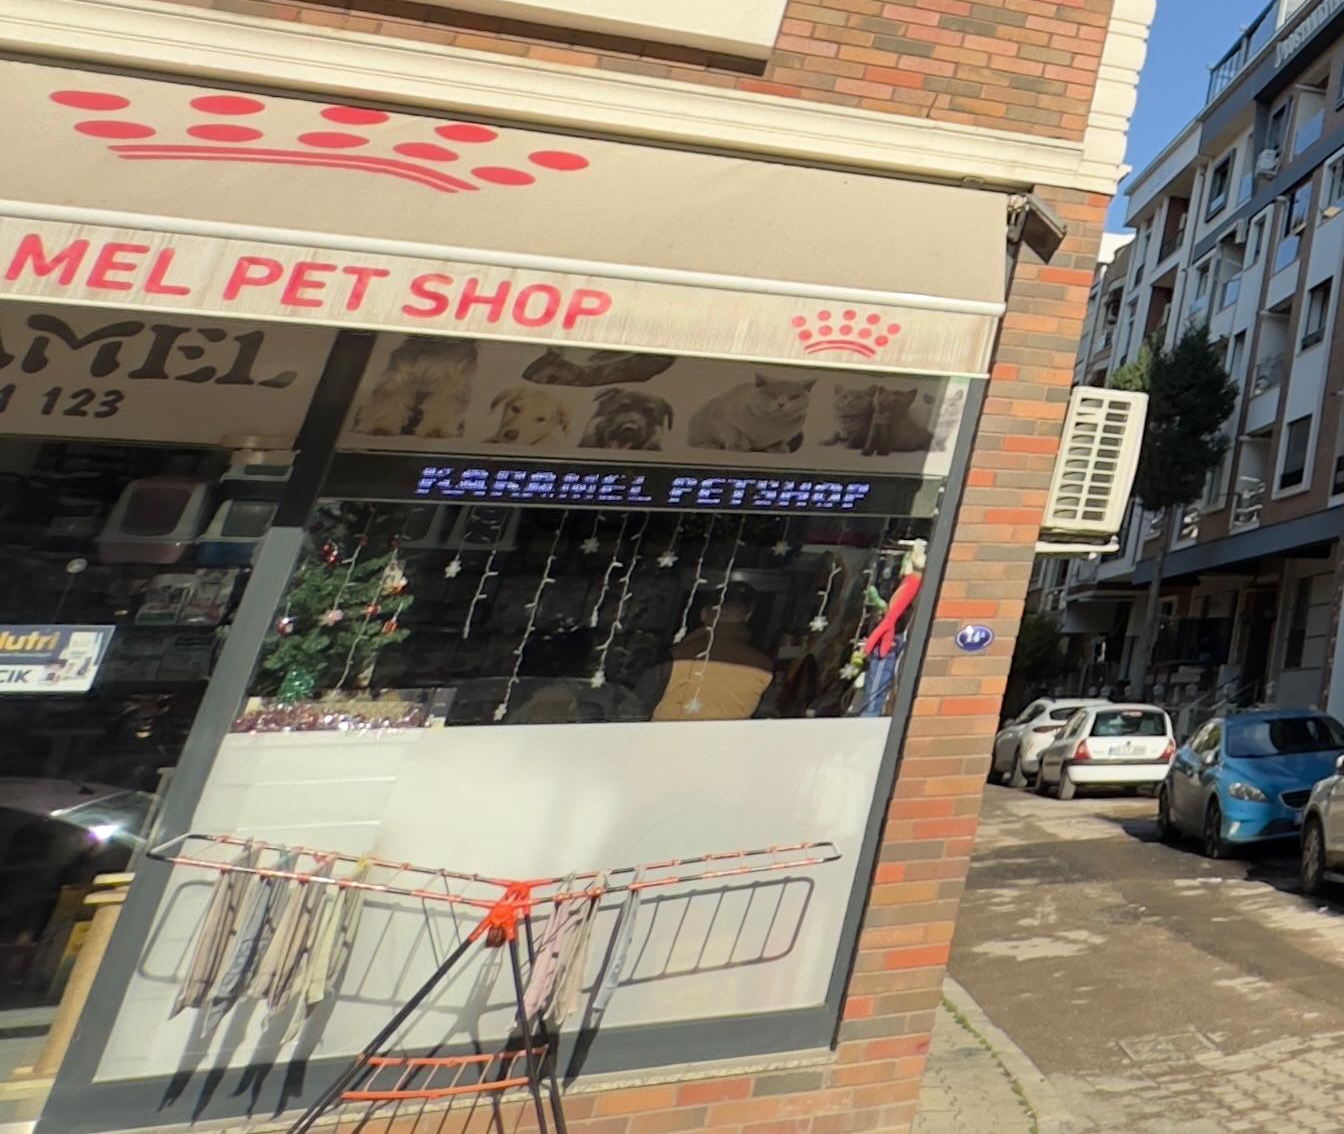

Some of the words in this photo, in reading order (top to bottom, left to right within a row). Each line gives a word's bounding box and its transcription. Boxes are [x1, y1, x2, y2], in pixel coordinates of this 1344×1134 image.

[4, 233, 191, 296] MEL
[222, 255, 391, 312] PET
[401, 273, 613, 331] SHOP
[0, 314, 297, 389] MEL
[41, 386, 125, 418] 123
[414, 466, 652, 502] KARAMEL
[667, 476, 871, 509] PETSHOP
